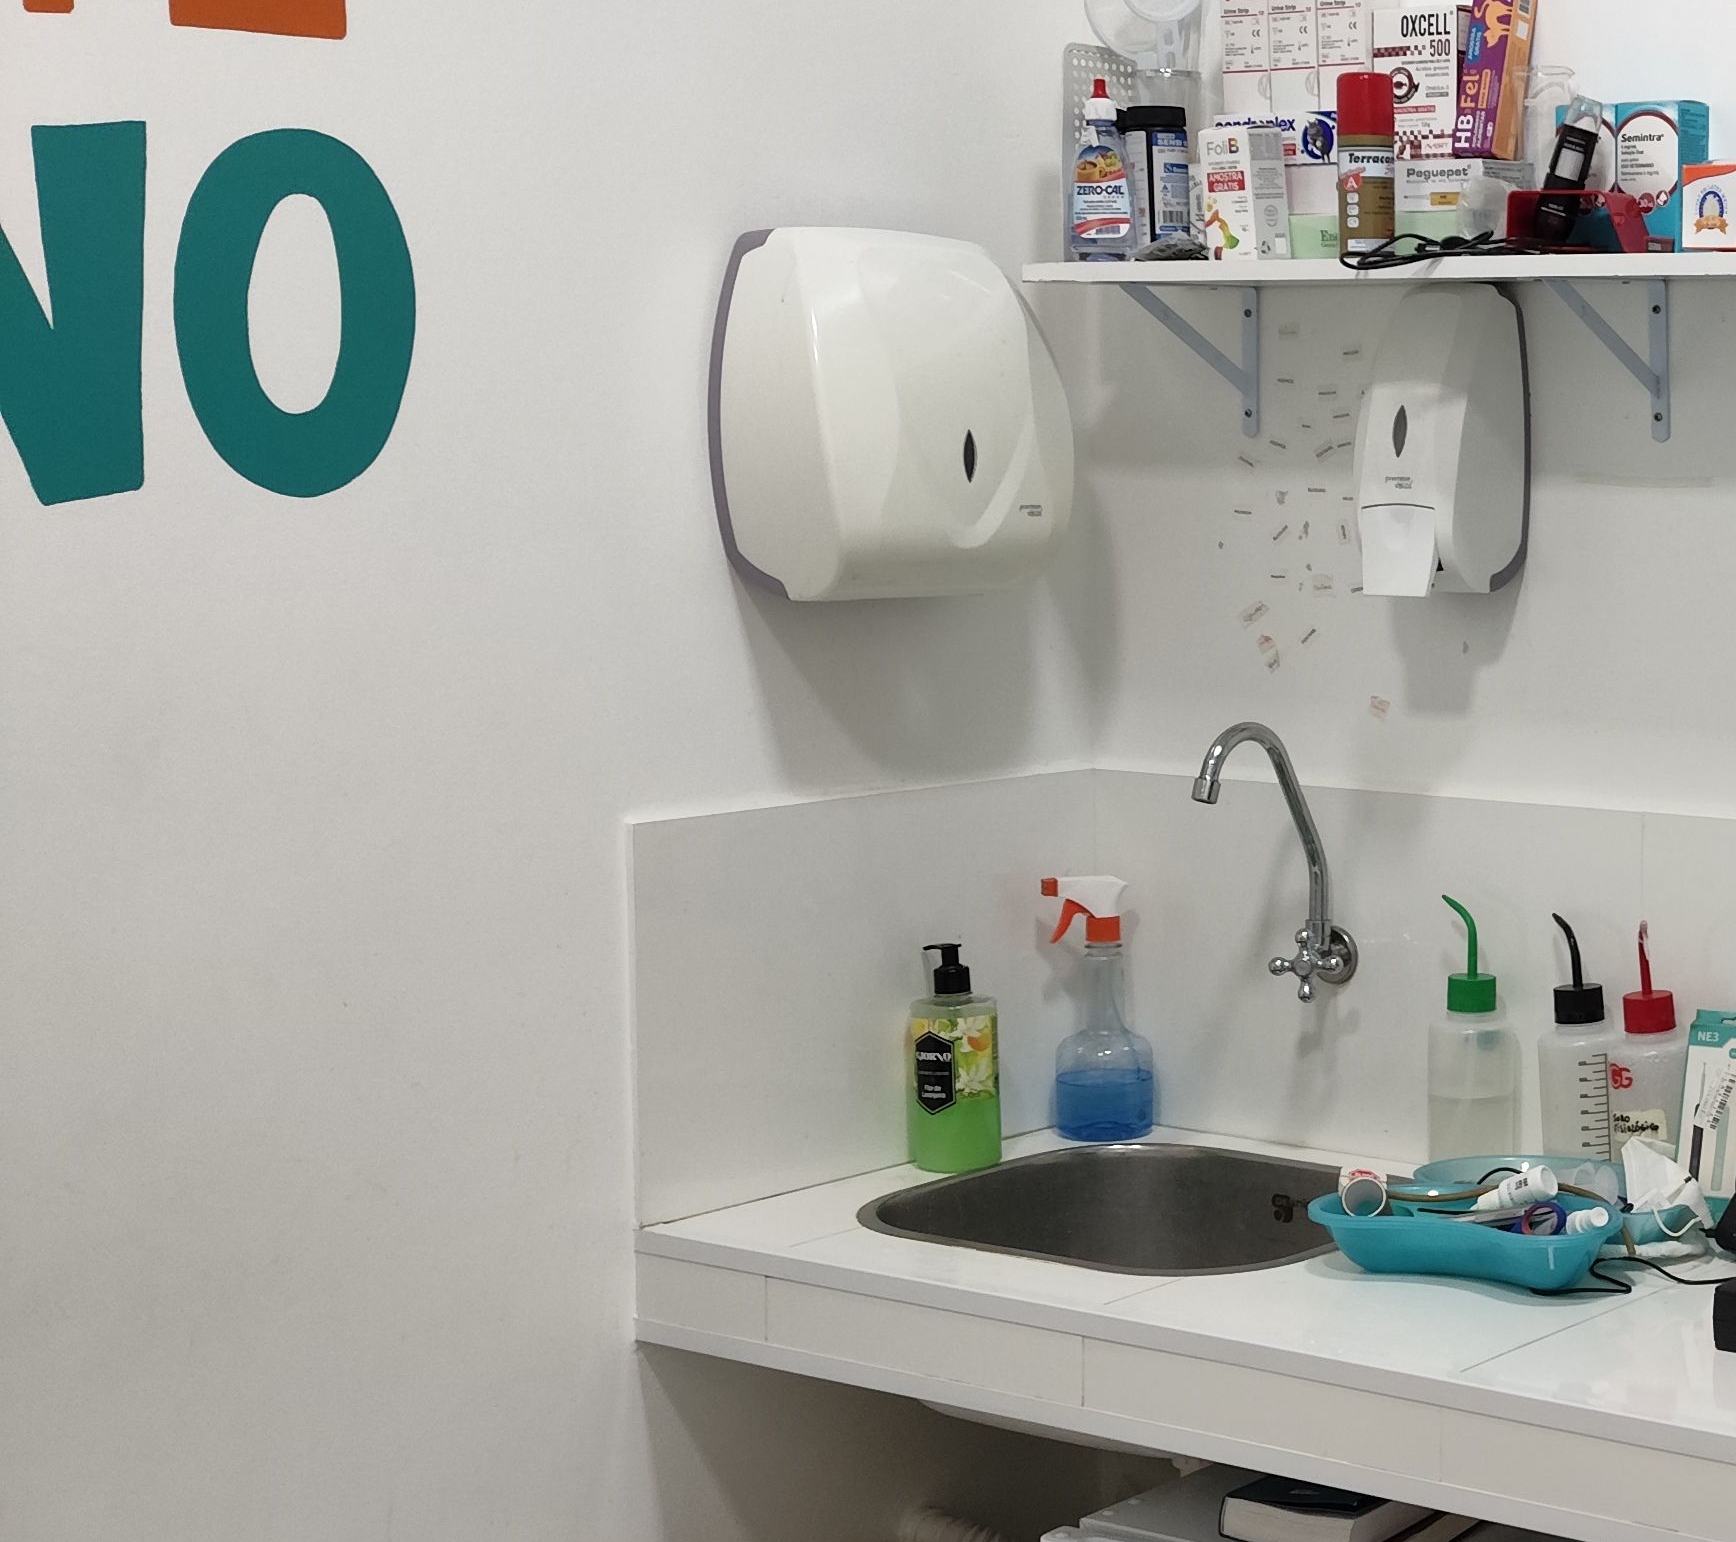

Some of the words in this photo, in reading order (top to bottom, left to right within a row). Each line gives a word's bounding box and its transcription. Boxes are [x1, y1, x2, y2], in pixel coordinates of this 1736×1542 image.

[1401, 12, 1450, 38] OXCELL
[1430, 38, 1450, 57] 500
[1460, 73, 1480, 108] Fel
[1455, 114, 1474, 148] HB
[1621, 133, 1662, 143] Semintra
[1208, 172, 1243, 181] AMOSTRA
[1406, 167, 1469, 179] Peguepet
[1077, 185, 1125, 195] ZERO-CAL
[1697, 1031, 1720, 1042] NE3
